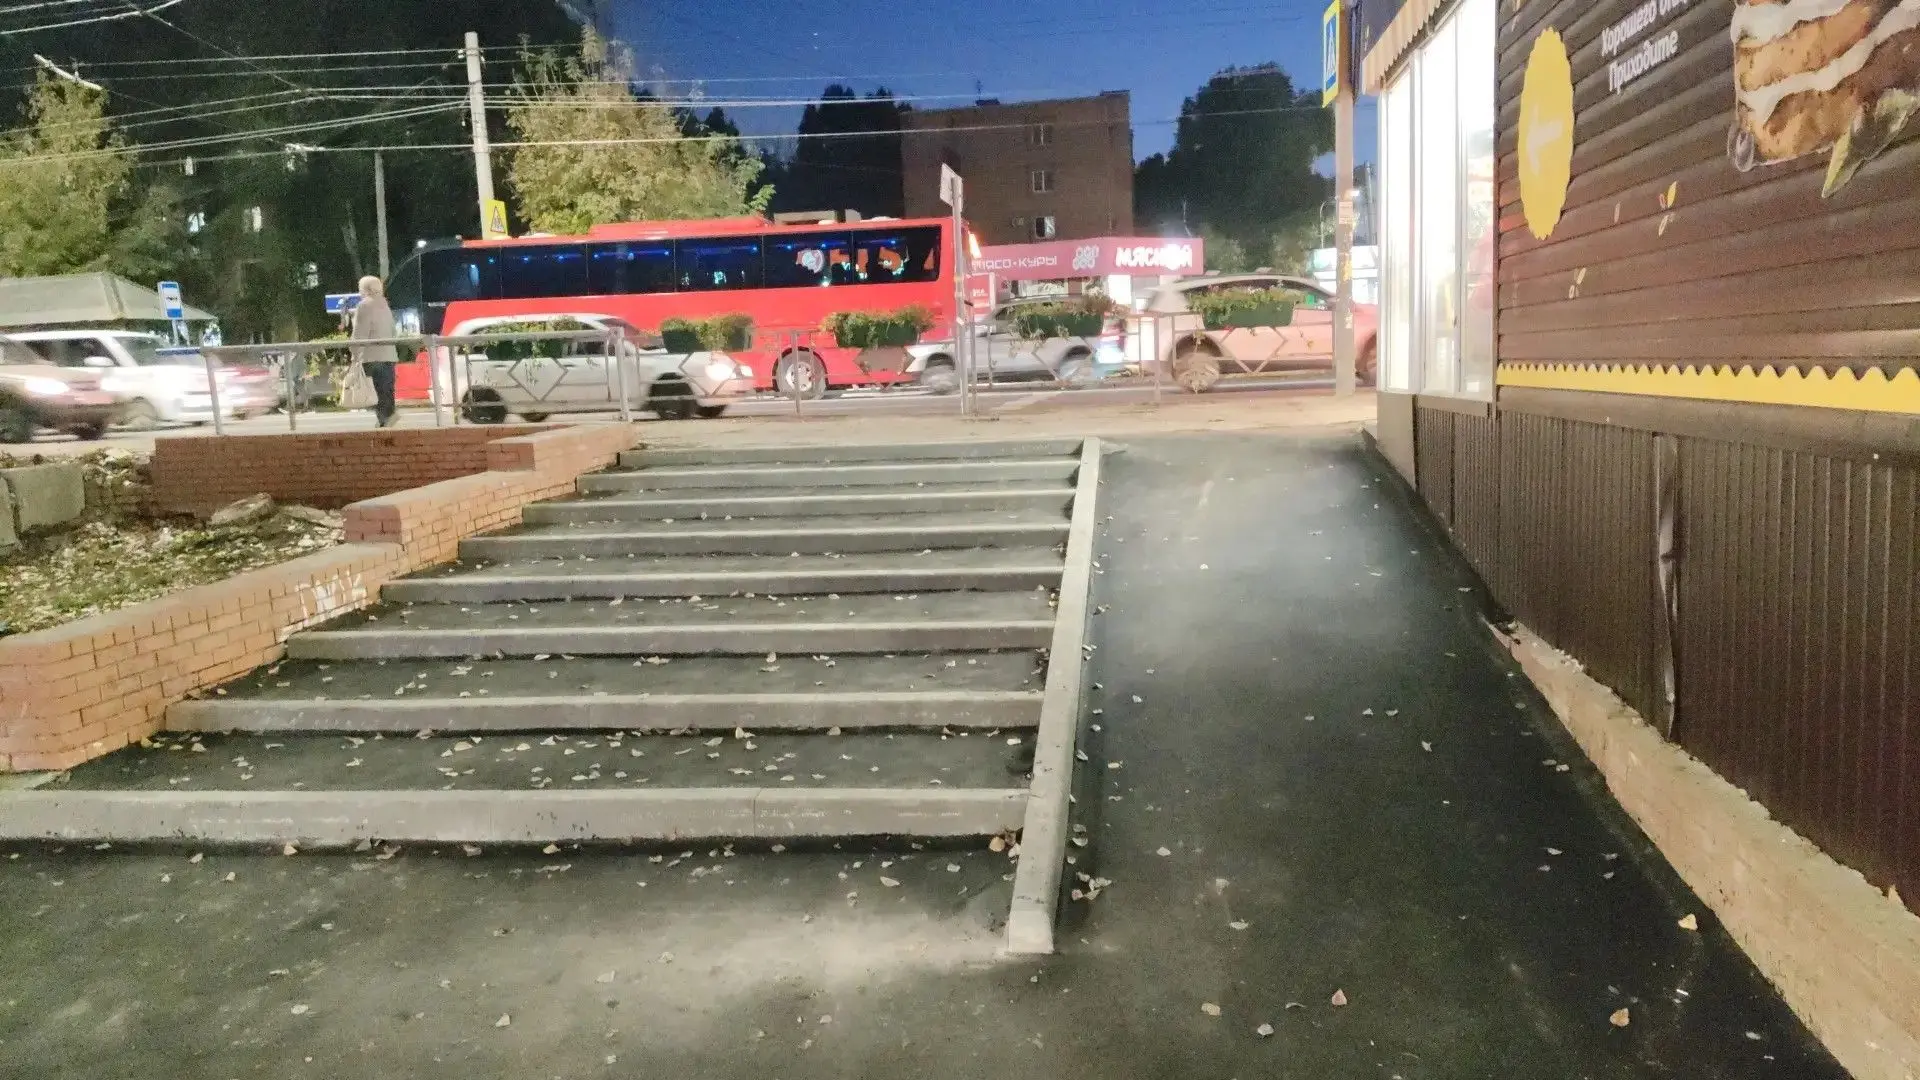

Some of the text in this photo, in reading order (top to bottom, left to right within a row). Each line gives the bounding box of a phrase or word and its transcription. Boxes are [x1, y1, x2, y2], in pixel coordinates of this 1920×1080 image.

[1602, 0, 1658, 57] Хорошего
[1609, 30, 1678, 95] Приходите
[1116, 245, 1193, 268] МЯСНЙ
